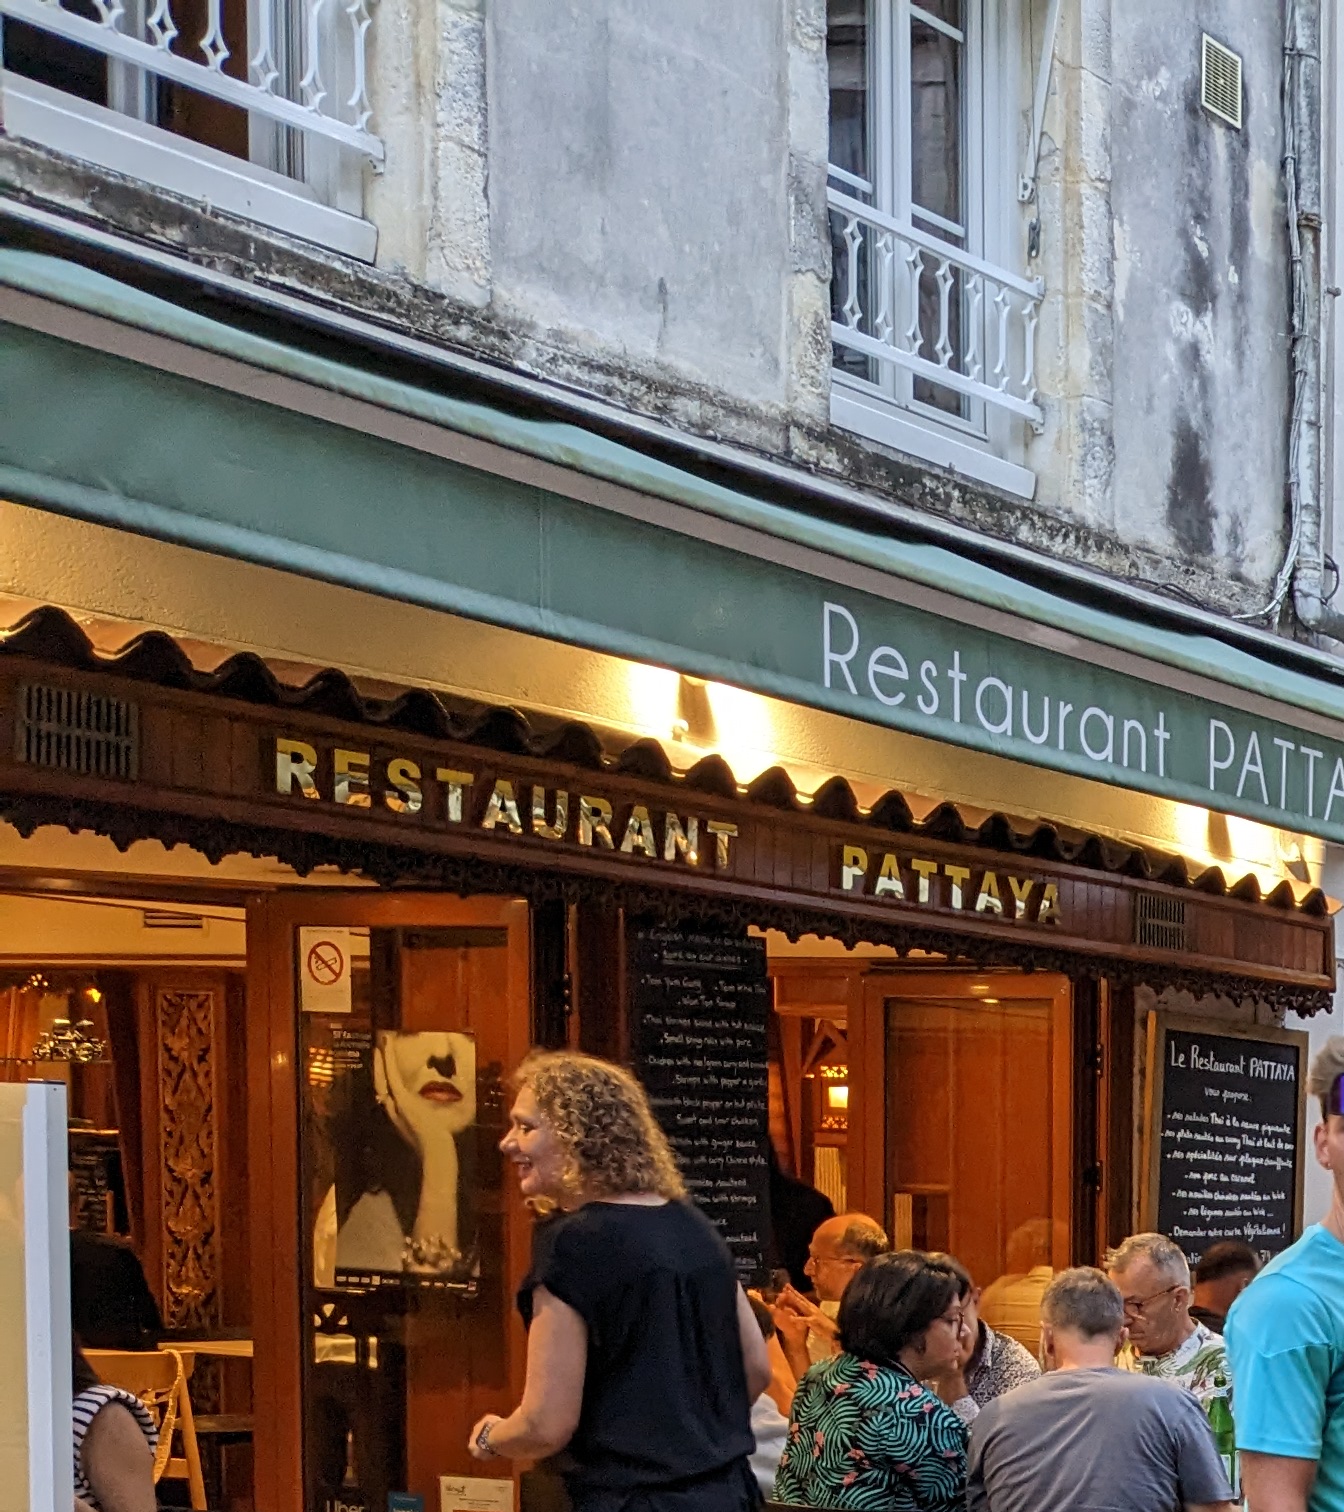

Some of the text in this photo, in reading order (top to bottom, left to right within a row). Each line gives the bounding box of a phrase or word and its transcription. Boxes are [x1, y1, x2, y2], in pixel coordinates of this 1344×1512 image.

[821, 602, 1171, 778] Restaurant
[276, 738, 738, 870] RESTAURANT
[842, 845, 1062, 926] PATTAYA
[1170, 1041, 1296, 1083] Le Restaurant PATTAYA
